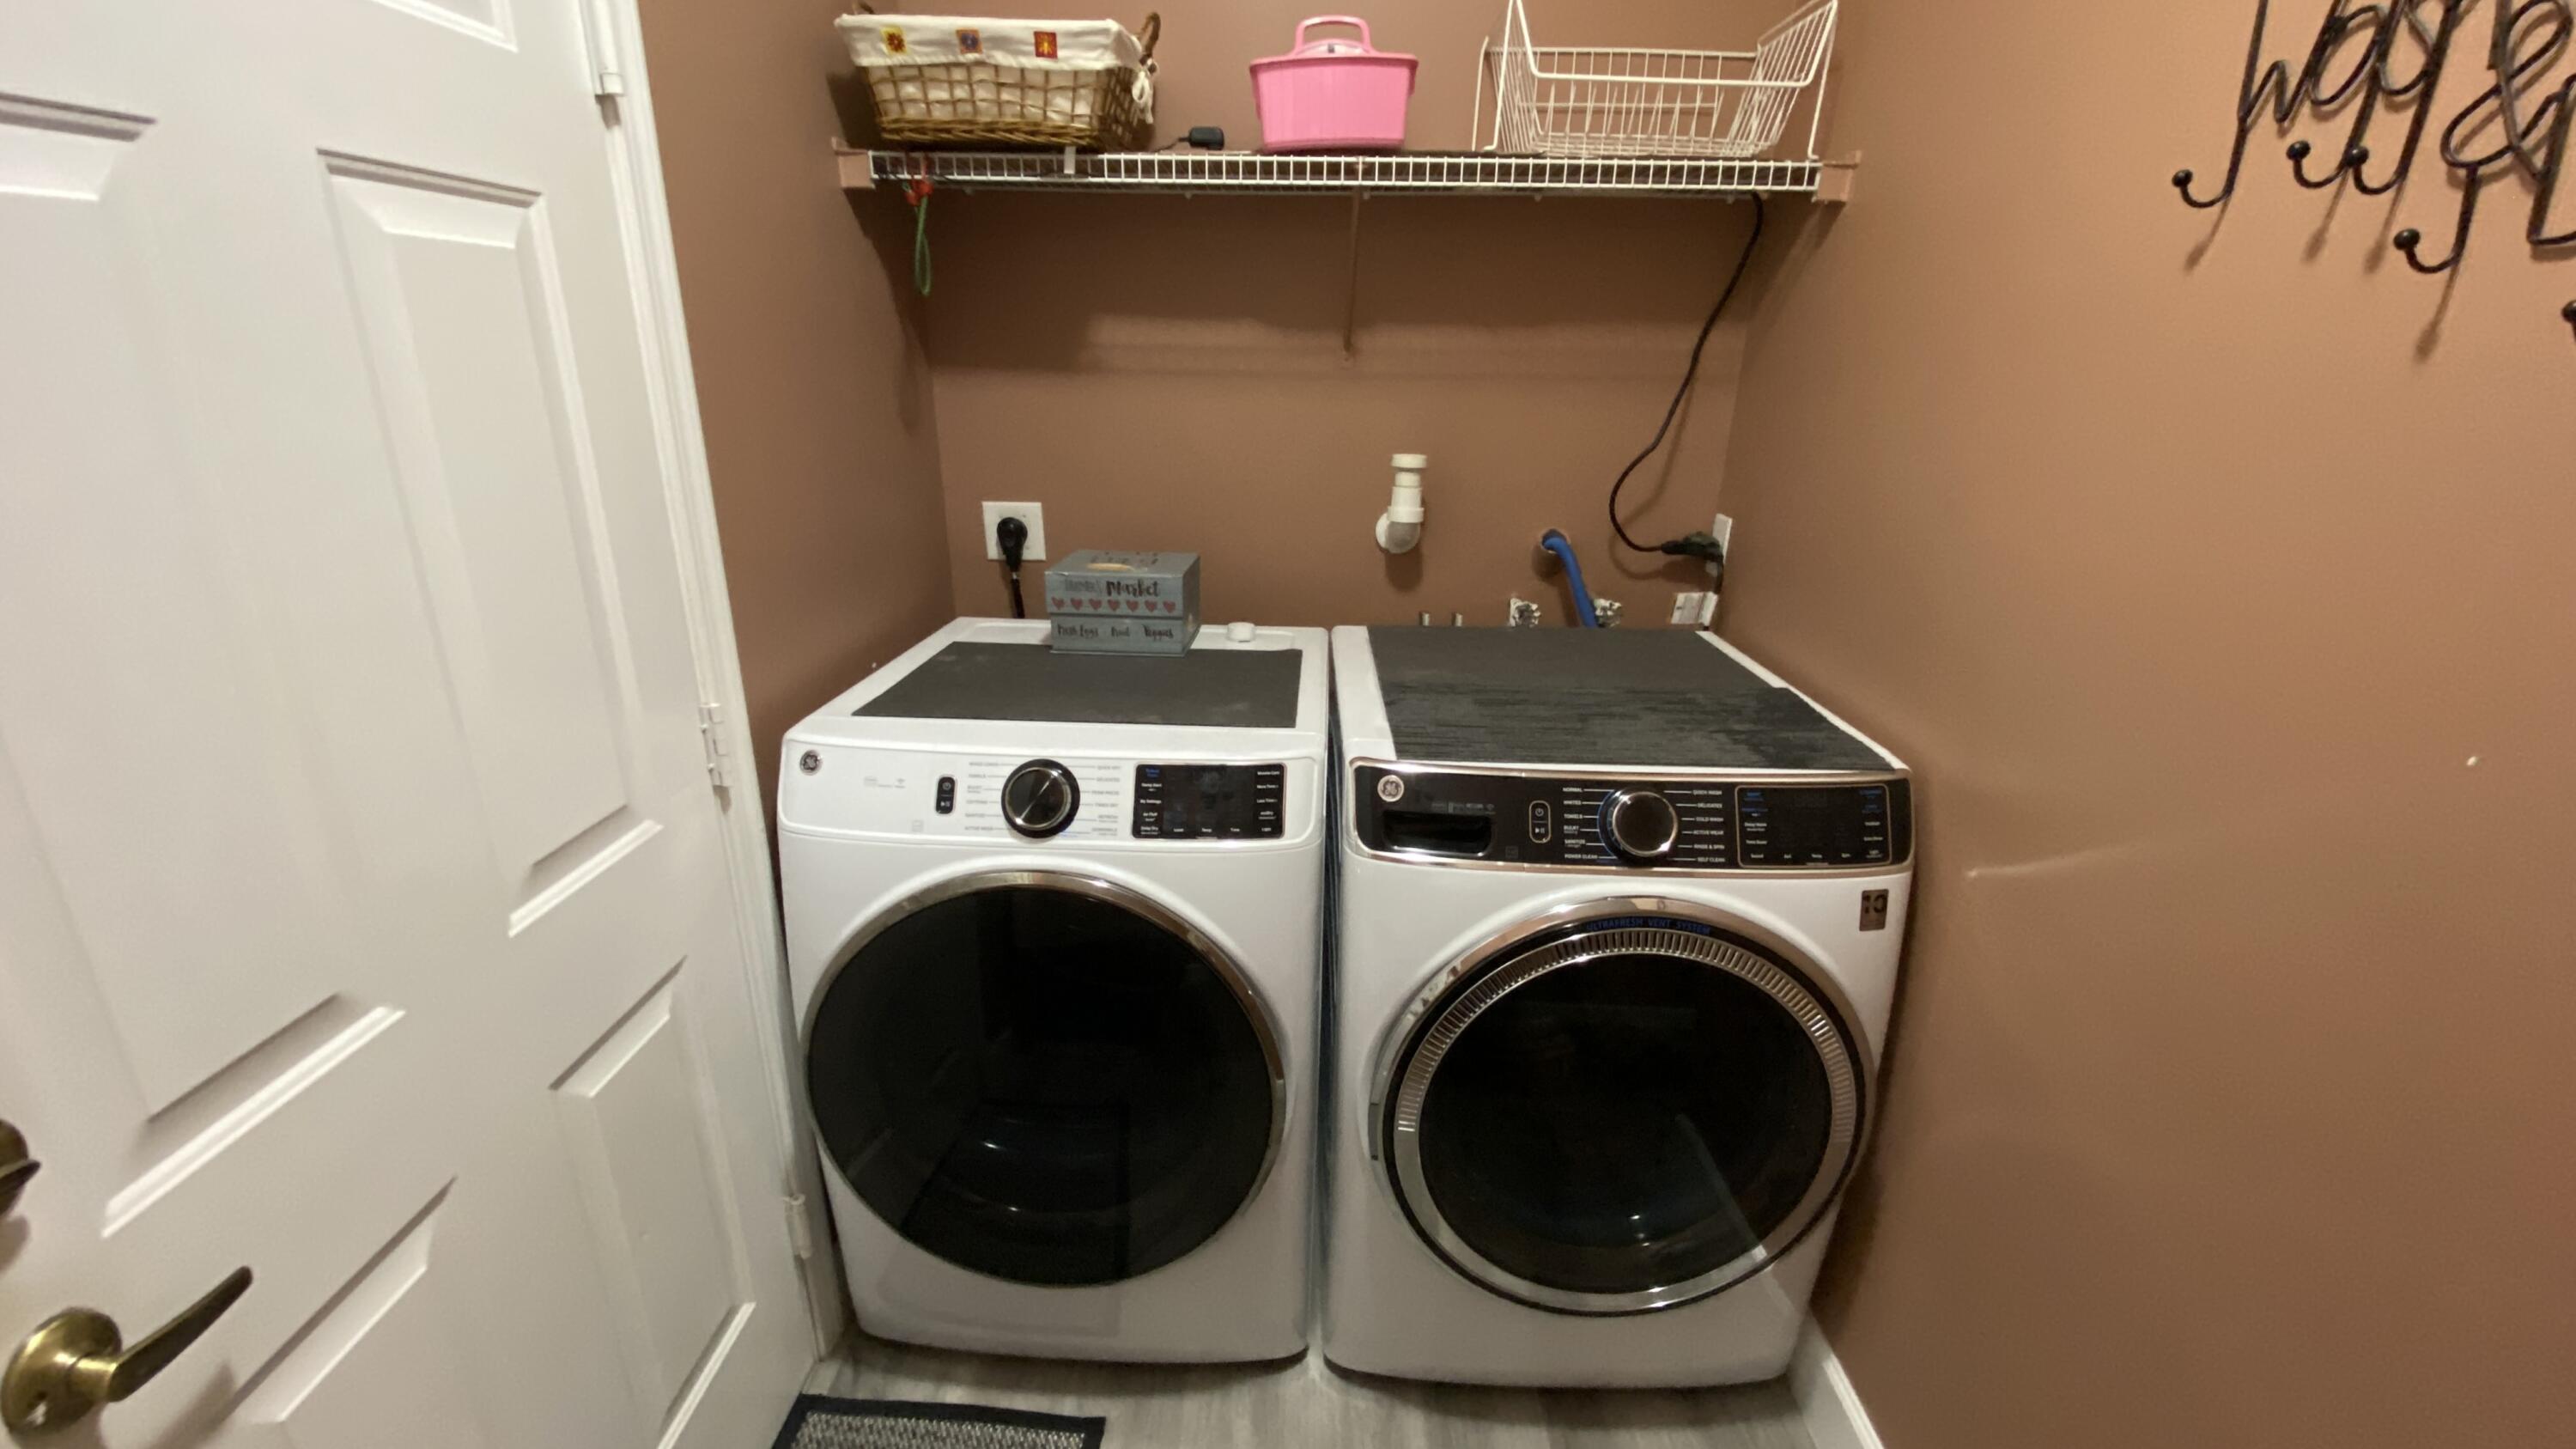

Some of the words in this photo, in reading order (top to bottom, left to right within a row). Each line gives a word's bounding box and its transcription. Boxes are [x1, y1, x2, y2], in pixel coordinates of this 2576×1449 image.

[1586, 917, 1644, 933] ULTRAFRESH
[1647, 918, 1671, 929] VENT
[1675, 920, 1711, 936] SYSTEM
